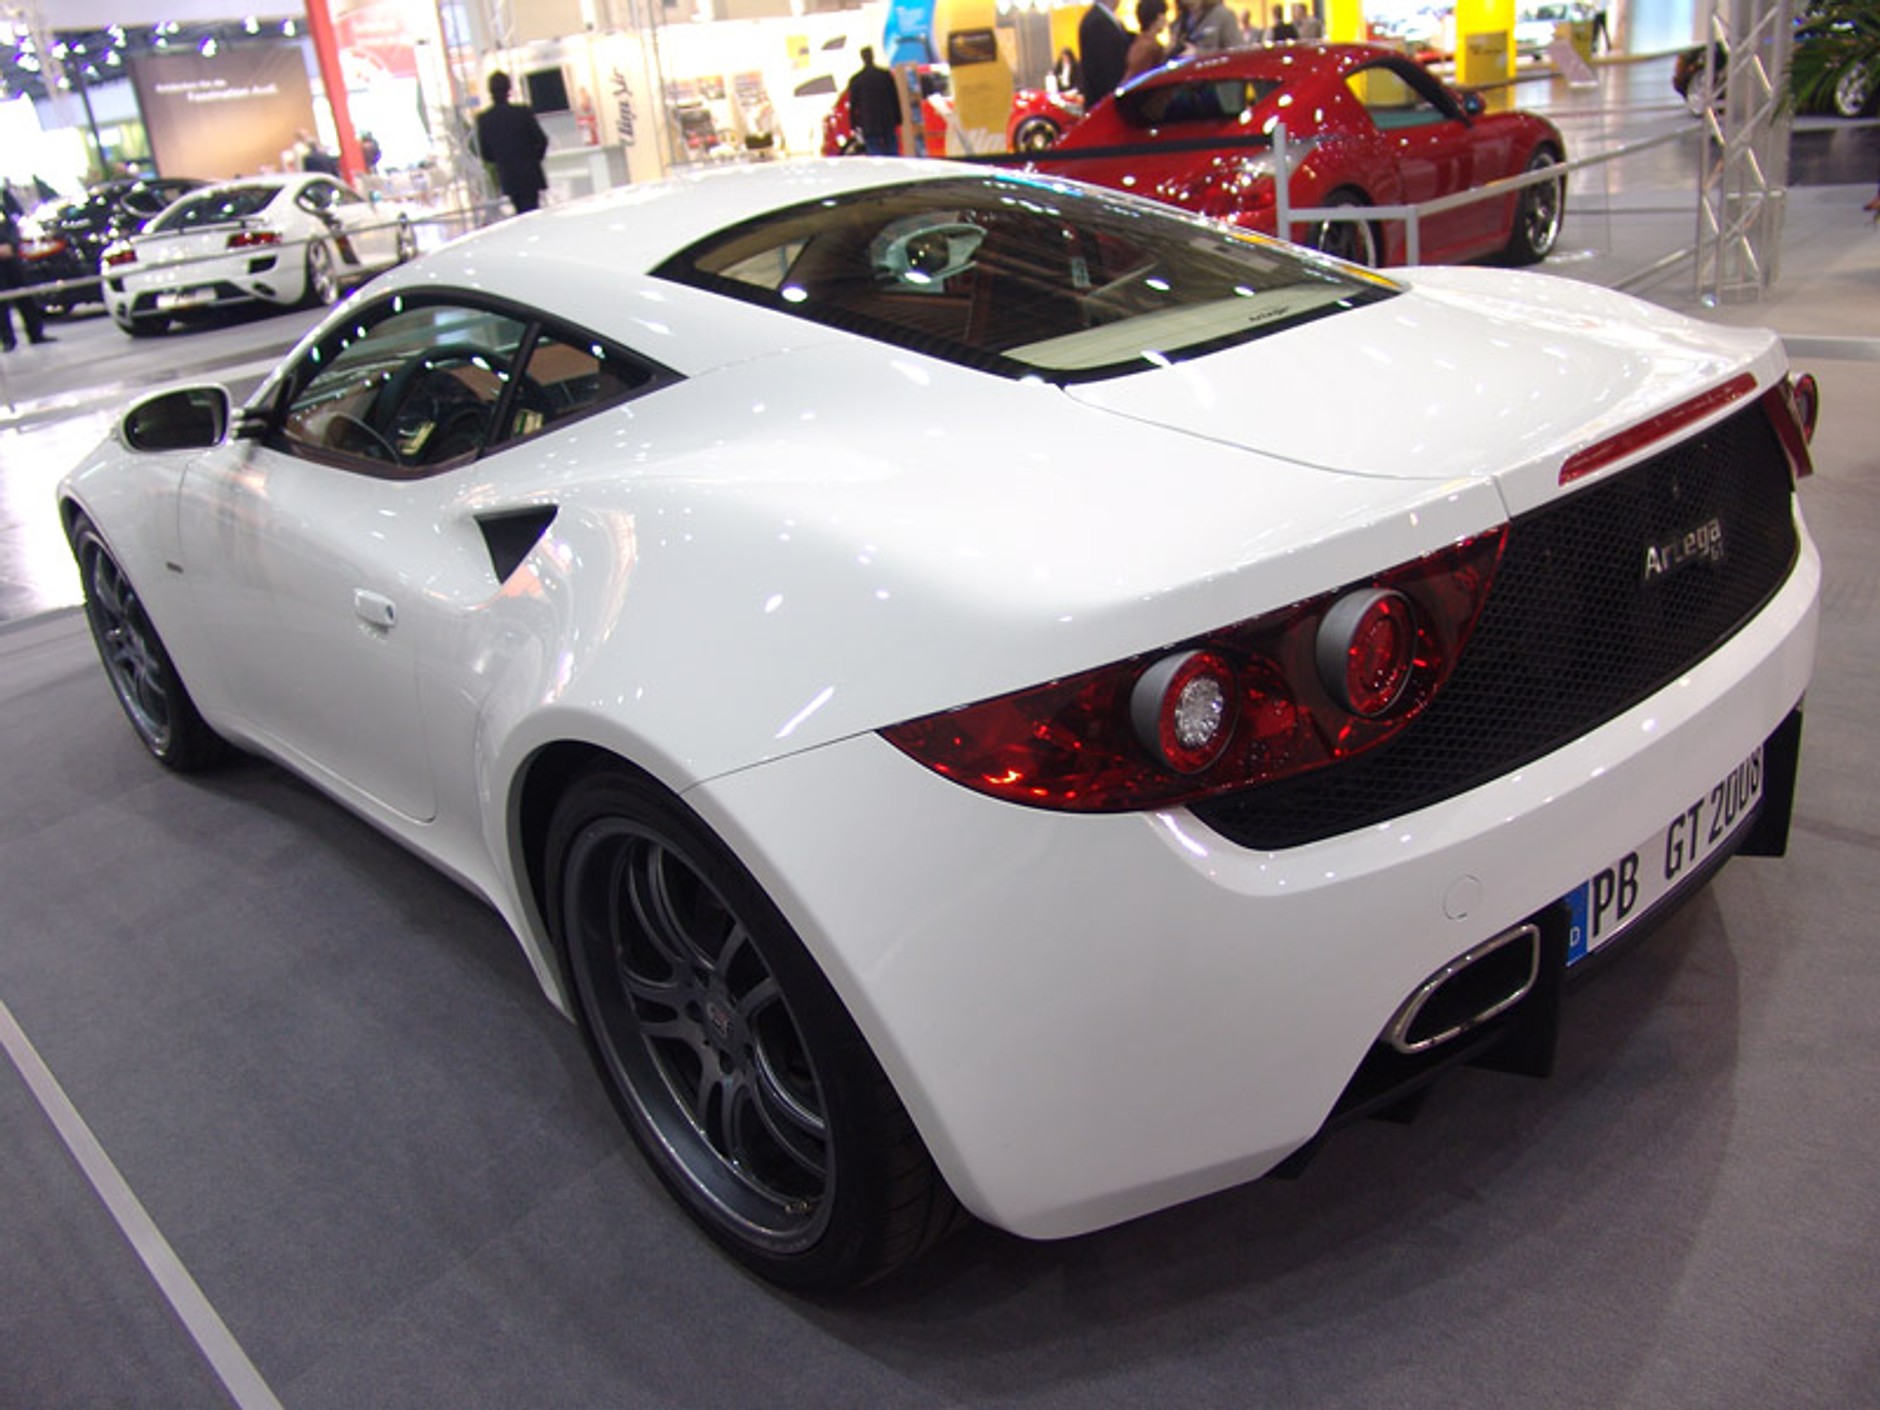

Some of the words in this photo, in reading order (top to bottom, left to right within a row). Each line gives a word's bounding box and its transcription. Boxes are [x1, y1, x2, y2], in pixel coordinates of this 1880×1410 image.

[1591, 851, 1639, 938] PB
[1664, 797, 1705, 880] GT
[1708, 746, 1761, 845] 2008
[1569, 926, 1581, 947] D
